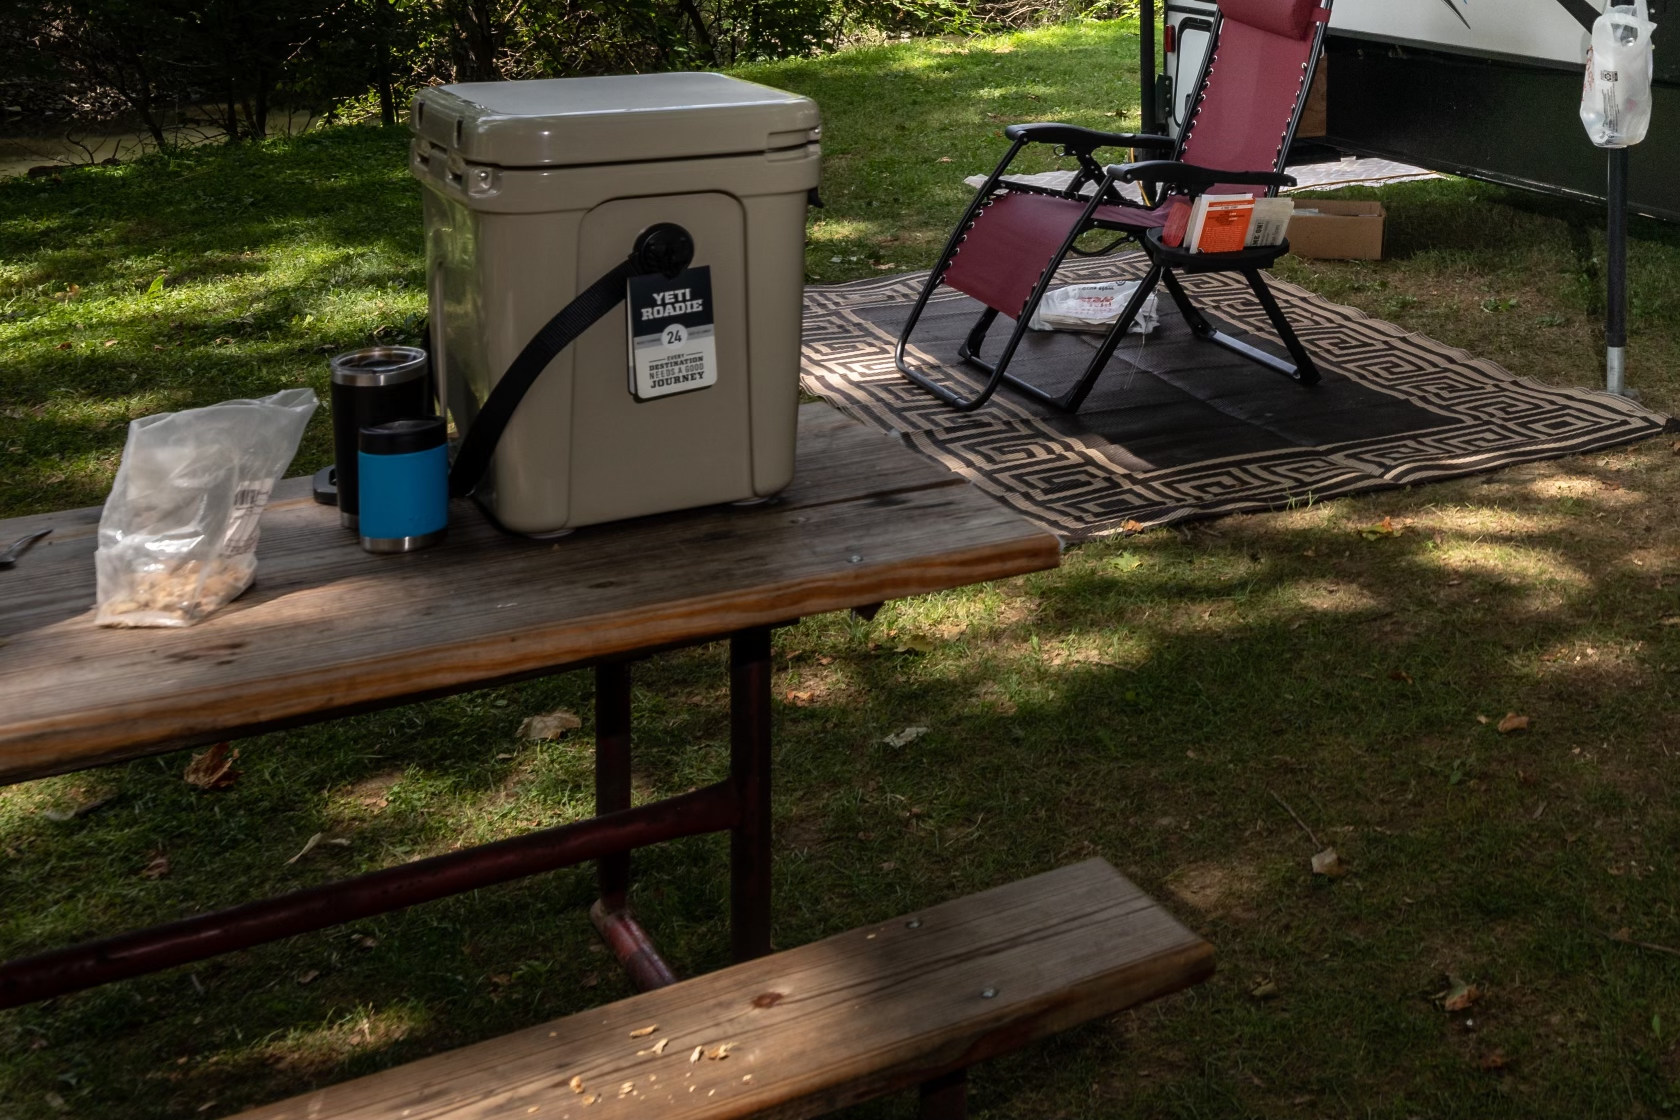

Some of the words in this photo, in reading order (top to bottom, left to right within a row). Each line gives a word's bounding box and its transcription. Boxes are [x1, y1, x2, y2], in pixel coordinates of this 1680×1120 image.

[653, 288, 691, 304] YETI
[641, 299, 703, 321] ROADIE
[667, 330, 682, 344] 24
[649, 355, 704, 371] DESTINATION
[649, 367, 676, 380] NEEDS
[678, 365, 682, 374] A
[685, 362, 704, 374] GOOD
[650, 371, 705, 389] JOURNEY
